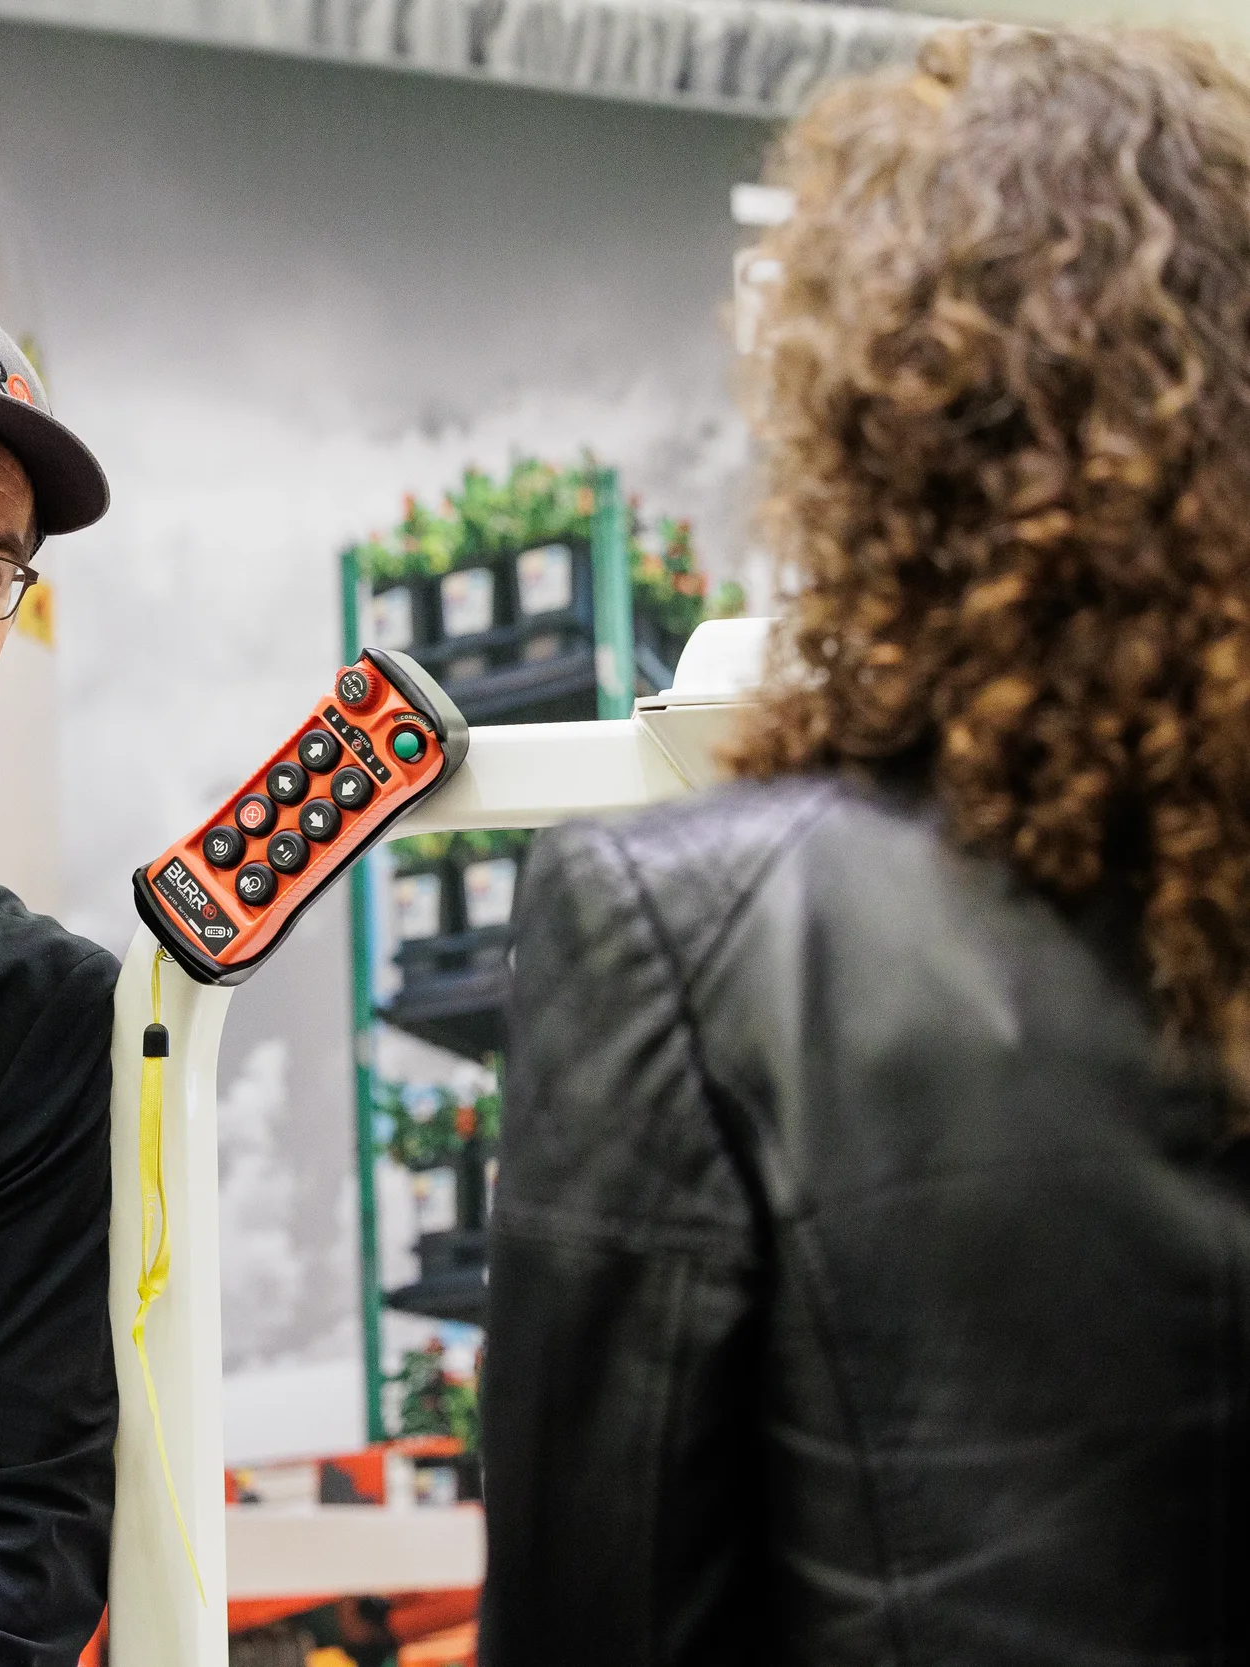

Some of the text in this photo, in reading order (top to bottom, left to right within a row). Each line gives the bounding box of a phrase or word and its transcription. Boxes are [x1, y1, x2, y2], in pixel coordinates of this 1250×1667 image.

[344, 676, 362, 698] ON/OFF
[400, 715, 427, 726] CONNECT
[353, 729, 371, 748] STATUS
[168, 895, 178, 905] with
[176, 887, 196, 910] Controller
